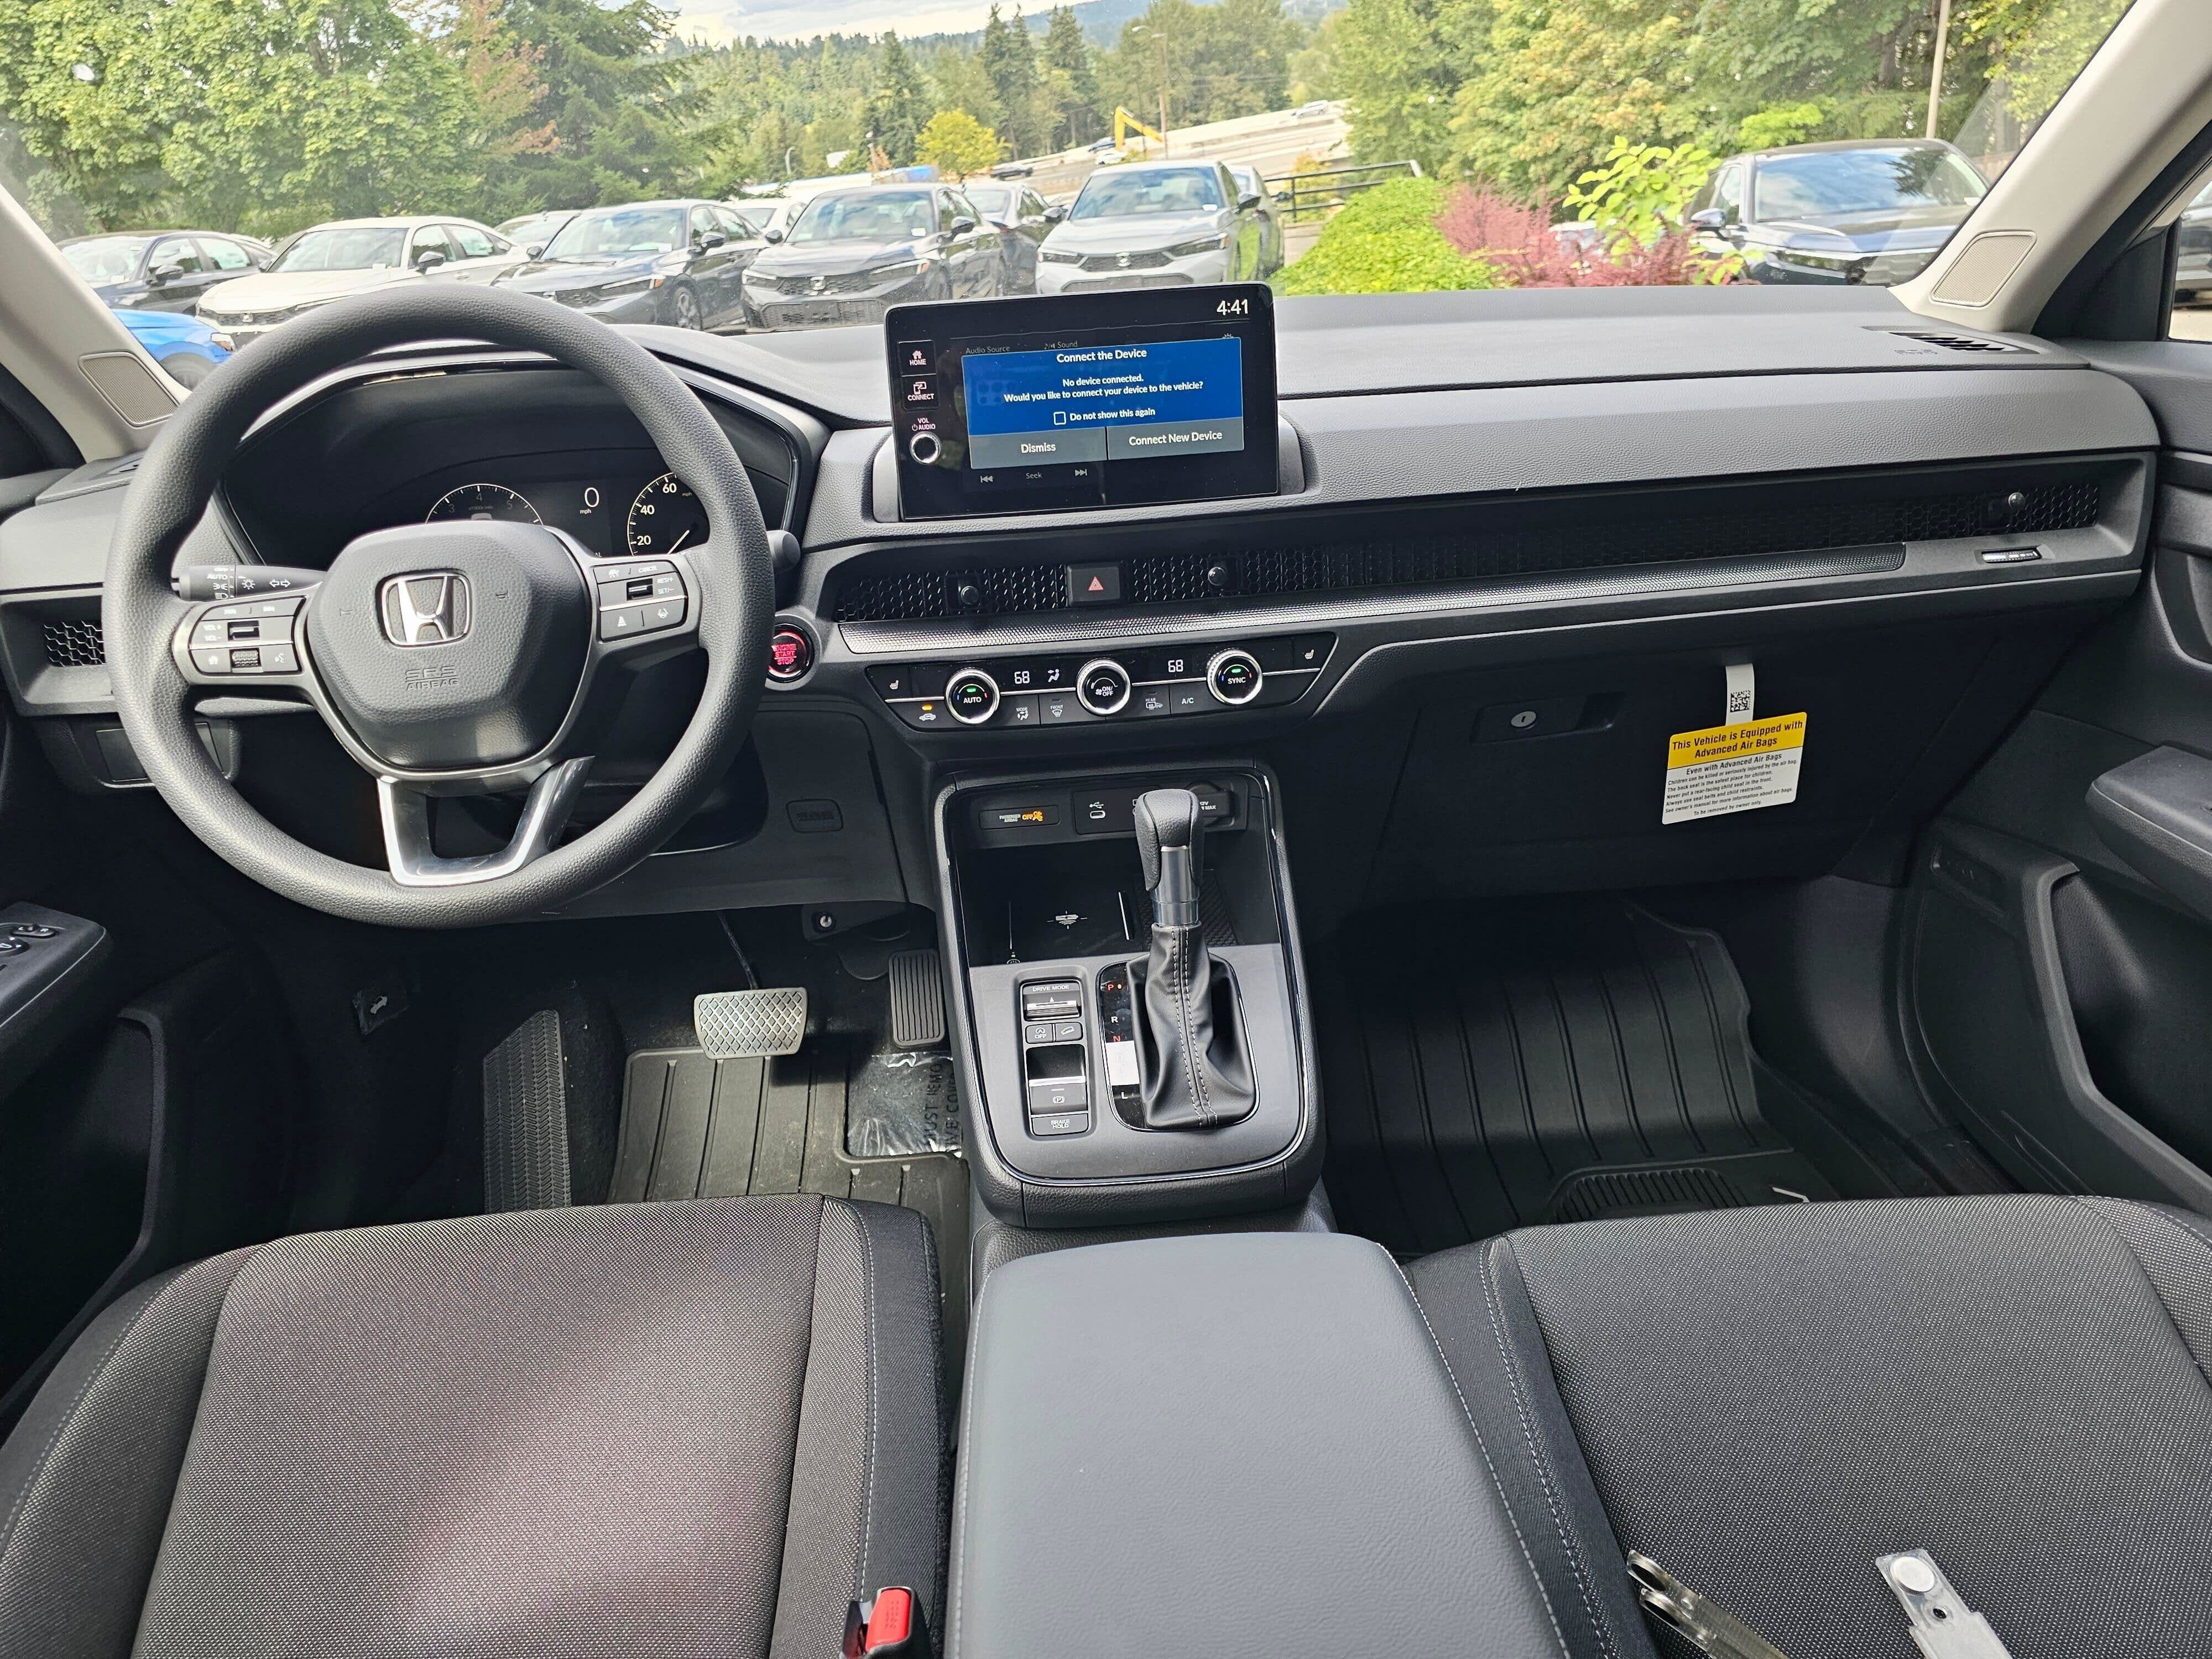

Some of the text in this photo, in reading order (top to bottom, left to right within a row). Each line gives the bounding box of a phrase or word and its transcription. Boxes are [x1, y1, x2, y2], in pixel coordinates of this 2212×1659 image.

[1217, 299, 1248, 316] 4:41
[1056, 348, 1147, 363] Connect the Device
[1062, 373, 1144, 387] No device connected.
[1003, 393, 1030, 402] Would
[1031, 393, 1046, 402] you
[1047, 390, 1061, 399] like
[1072, 388, 1103, 398] connect
[1103, 388, 1122, 397] your
[1123, 385, 1147, 394] device
[1149, 384, 1158, 393] to
[1159, 383, 1172, 392] the
[1173, 381, 1203, 390] vehicle?
[1070, 407, 1156, 421] Do not show this again
[1129, 431, 1222, 446] Connect New Device
[1021, 442, 1056, 453] Dismiss
[662, 483, 677, 493] 60
[476, 493, 482, 502] 4
[507, 500, 513, 509] 5
[585, 487, 599, 508] 0
[448, 504, 455, 513] 3
[640, 504, 655, 515] 40
[637, 535, 651, 546] 20
[405, 665, 455, 680] SRS
[1168, 659, 1183, 672] 68
[406, 678, 459, 691] AIRBAG
[1014, 671, 1030, 684] 68
[1672, 720, 1803, 750] This Vehicle is Equipped with
[1694, 738, 1777, 758] Advanced Air Bags
[1686, 767, 1702, 775] Even
[1719, 757, 1752, 769] Advanced
